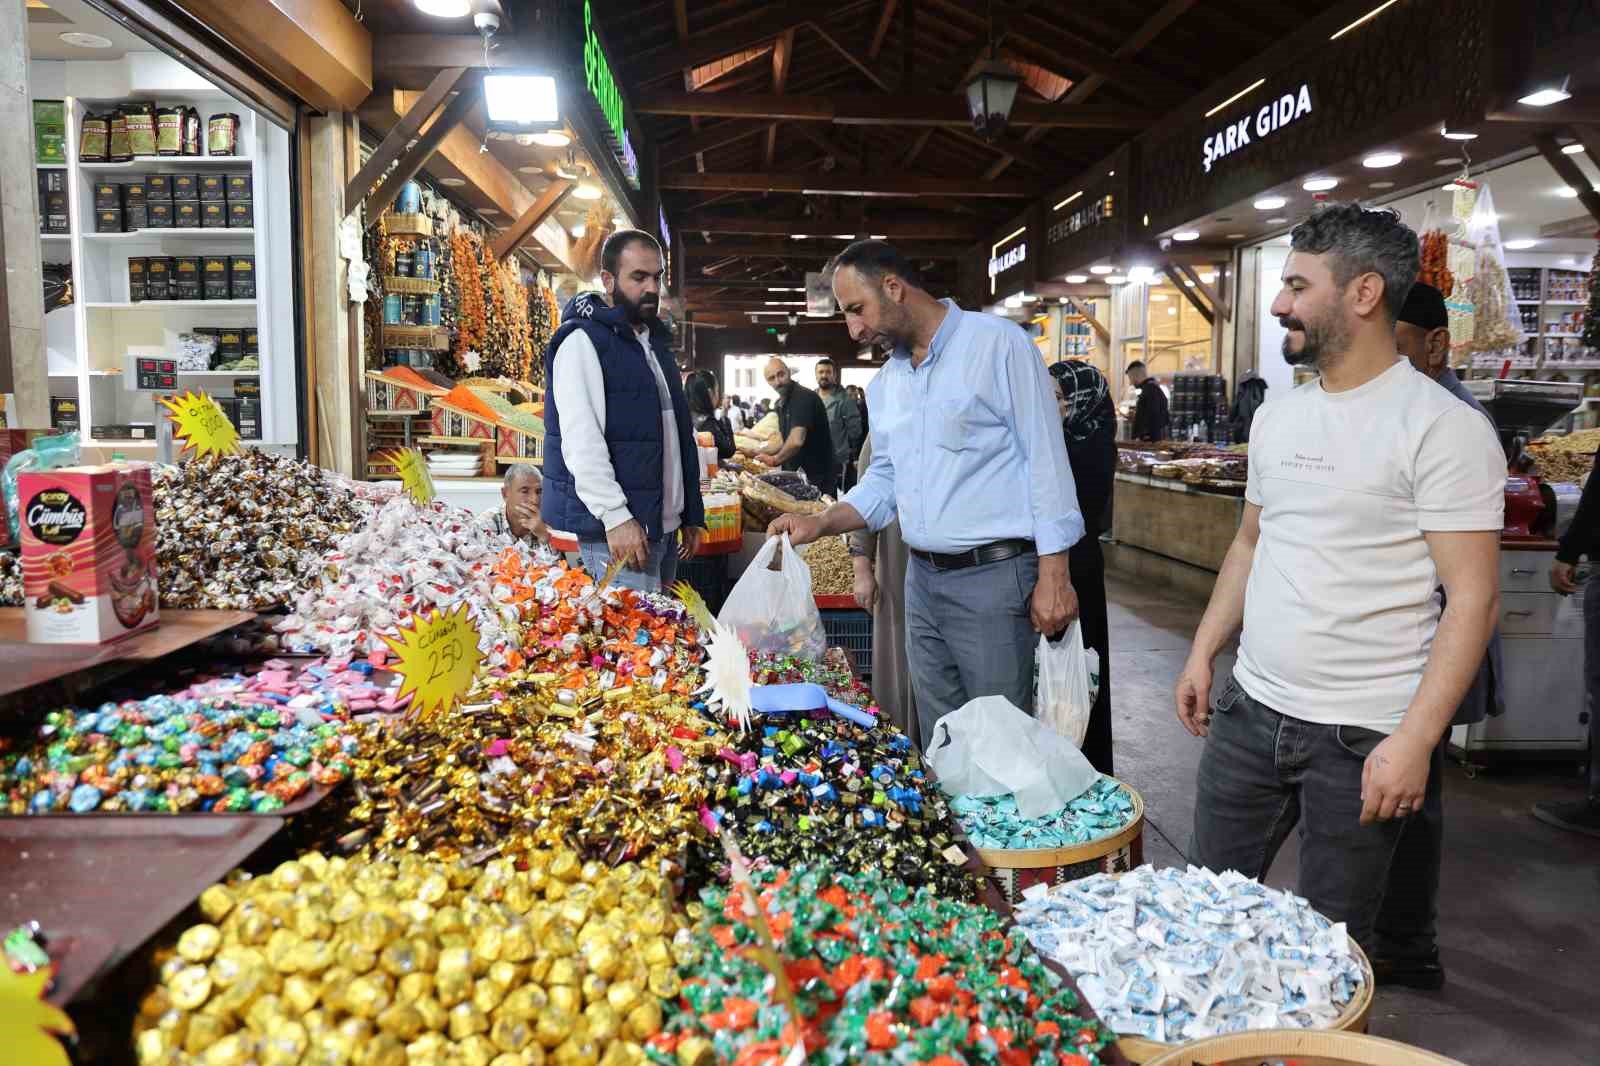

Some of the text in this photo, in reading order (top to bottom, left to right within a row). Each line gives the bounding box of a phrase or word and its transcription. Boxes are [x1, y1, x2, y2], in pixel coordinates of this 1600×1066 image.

[1203, 84, 1312, 172] ŞARK GIDA
[427, 637, 464, 684] 250
